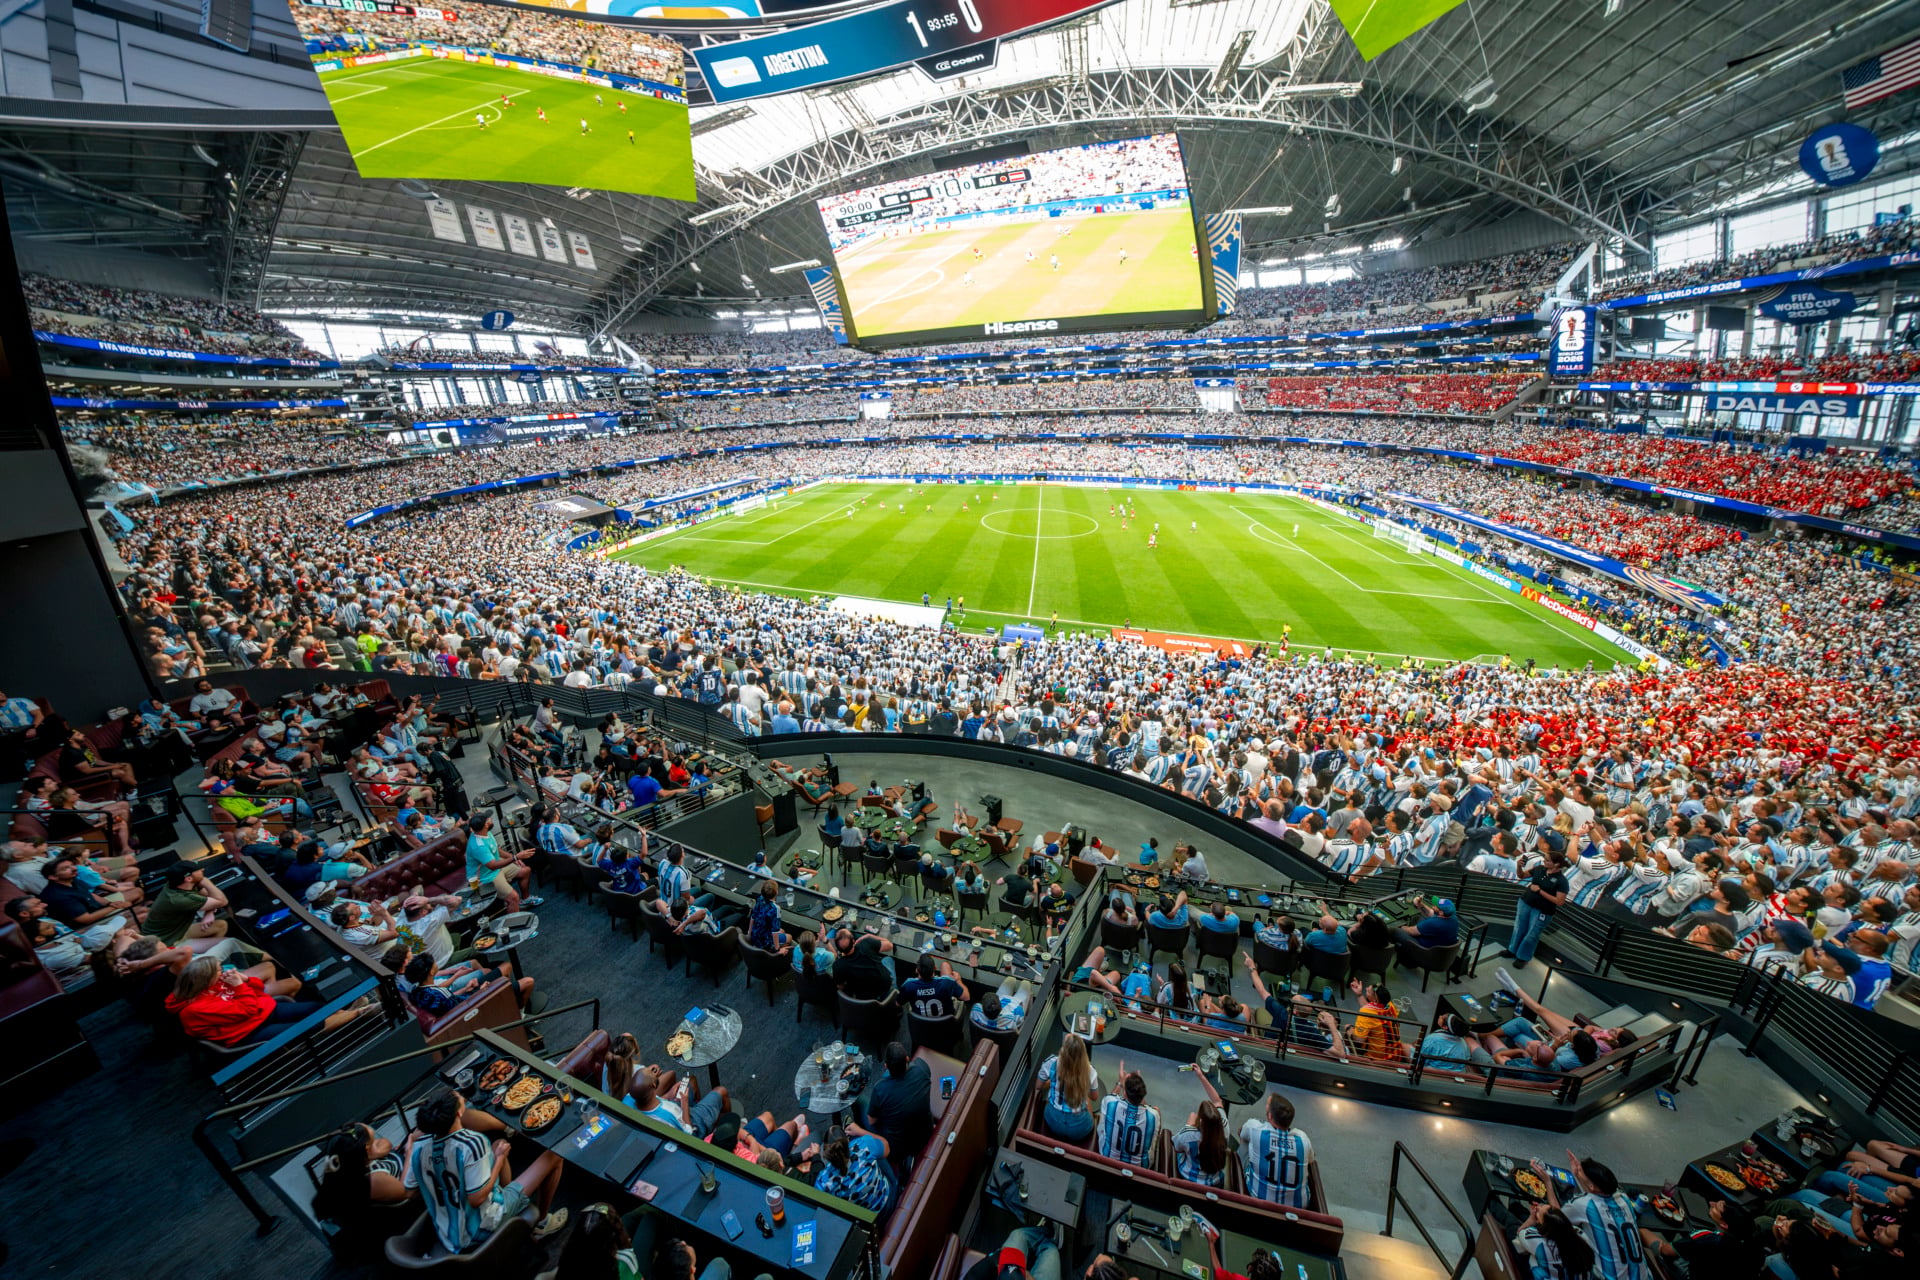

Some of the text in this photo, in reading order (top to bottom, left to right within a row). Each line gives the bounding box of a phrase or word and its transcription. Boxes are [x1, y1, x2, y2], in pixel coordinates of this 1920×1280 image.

[907, 0, 982, 48] 1 93:55 0
[763, 45, 829, 76] ARGENTINA
[839, 201, 873, 215] 90:00
[844, 216, 863, 226] 3:53
[865, 213, 877, 222] +5
[1647, 281, 1741, 302] FIFA WORLD CUP 2026
[1791, 293, 1815, 302] FIFA
[1775, 298, 1840, 311] WORLD CUP
[1788, 308, 1829, 318] 2026
[985, 318, 1058, 335] Hisense
[99, 342, 195, 360] FIFA WORLD CUP 2026
[1716, 396, 1848, 416] DALLAS
[506, 427, 524, 436] FIFA
[524, 426, 549, 435] WORLD
[550, 424, 564, 433] CUP
[1842, 524, 1881, 538] DALLAS
[1470, 562, 1512, 589] Hisense
[1565, 584, 1579, 595] FIFA
[1539, 596, 1595, 629] McDonald's
[1166, 638, 1212, 650] AUSTRIA
[1613, 636, 1641, 655] Dove
[702, 677, 716, 691] 10
[917, 988, 935, 996] MESSI
[915, 999, 943, 1017] 10
[1116, 1120, 1142, 1156] 10
[1271, 1138, 1295, 1150] MESSI
[1265, 1152, 1300, 1188] 10
[427, 1170, 460, 1209] 10
[1608, 1222, 1643, 1265] 10
